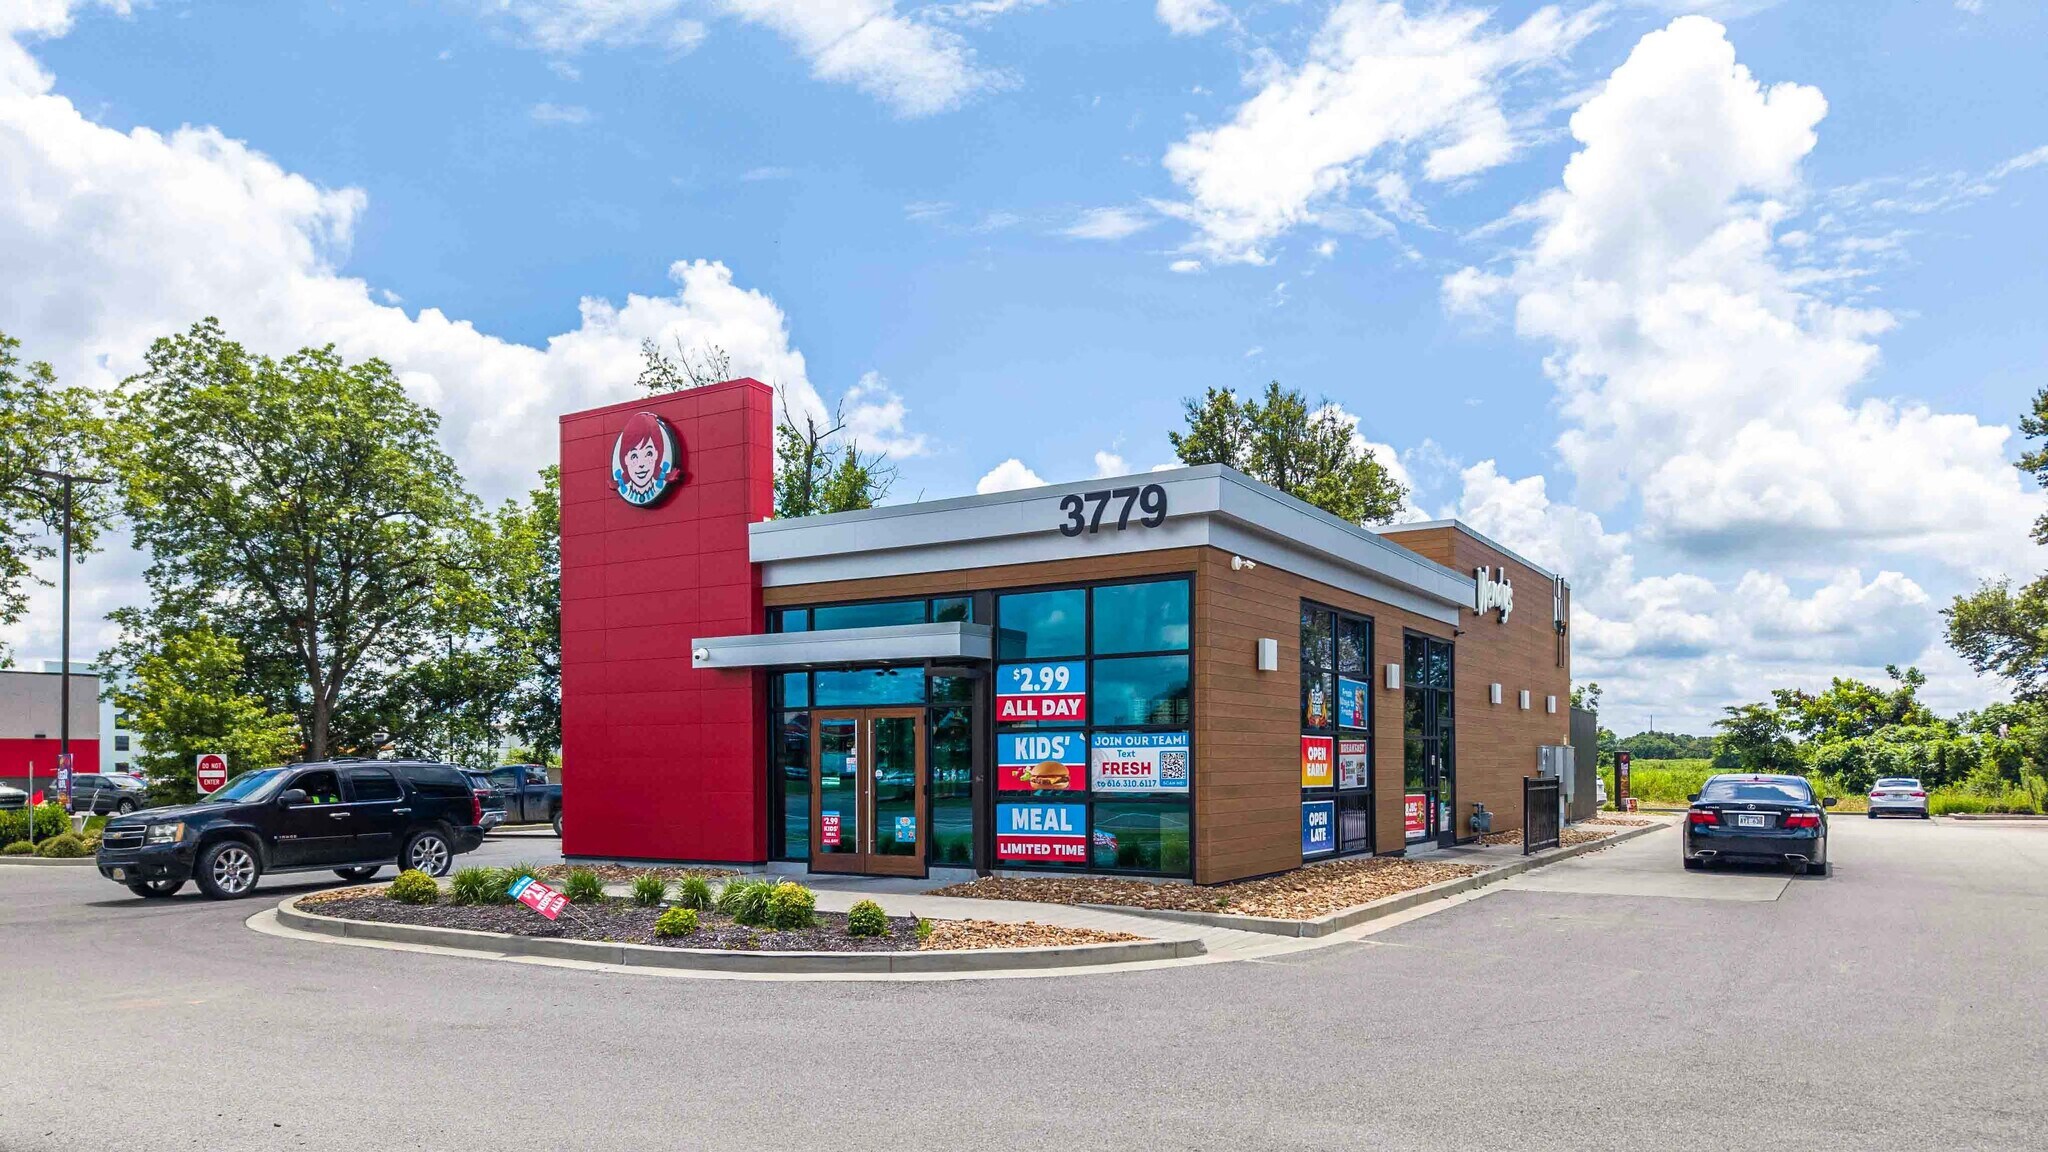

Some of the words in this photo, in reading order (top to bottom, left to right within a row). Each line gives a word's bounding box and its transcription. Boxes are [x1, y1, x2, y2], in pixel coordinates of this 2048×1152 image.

[1059, 484, 1167, 537] 3779
[1013, 666, 1070, 692] $2.99
[1002, 700, 1038, 717] ALL
[1041, 699, 1081, 716] DAY
[1015, 735, 1070, 760] KIDS'
[1095, 737, 1122, 746] JOIN
[1125, 736, 1149, 746] OUR
[1152, 735, 1186, 745] TEAM!
[1117, 749, 1136, 758] Text
[1308, 746, 1327, 761] OPEN
[1102, 762, 1151, 775] FRESH
[1306, 763, 1328, 777] EARLY
[1097, 780, 1106, 788] to
[1107, 780, 1157, 788] 616.310.6117
[1012, 808, 1073, 831] MEAL
[1309, 811, 1328, 827] OPEN
[1310, 828, 1327, 842] LATE
[1000, 843, 1051, 855] LIMITED
[1053, 844, 1085, 856] TIME
